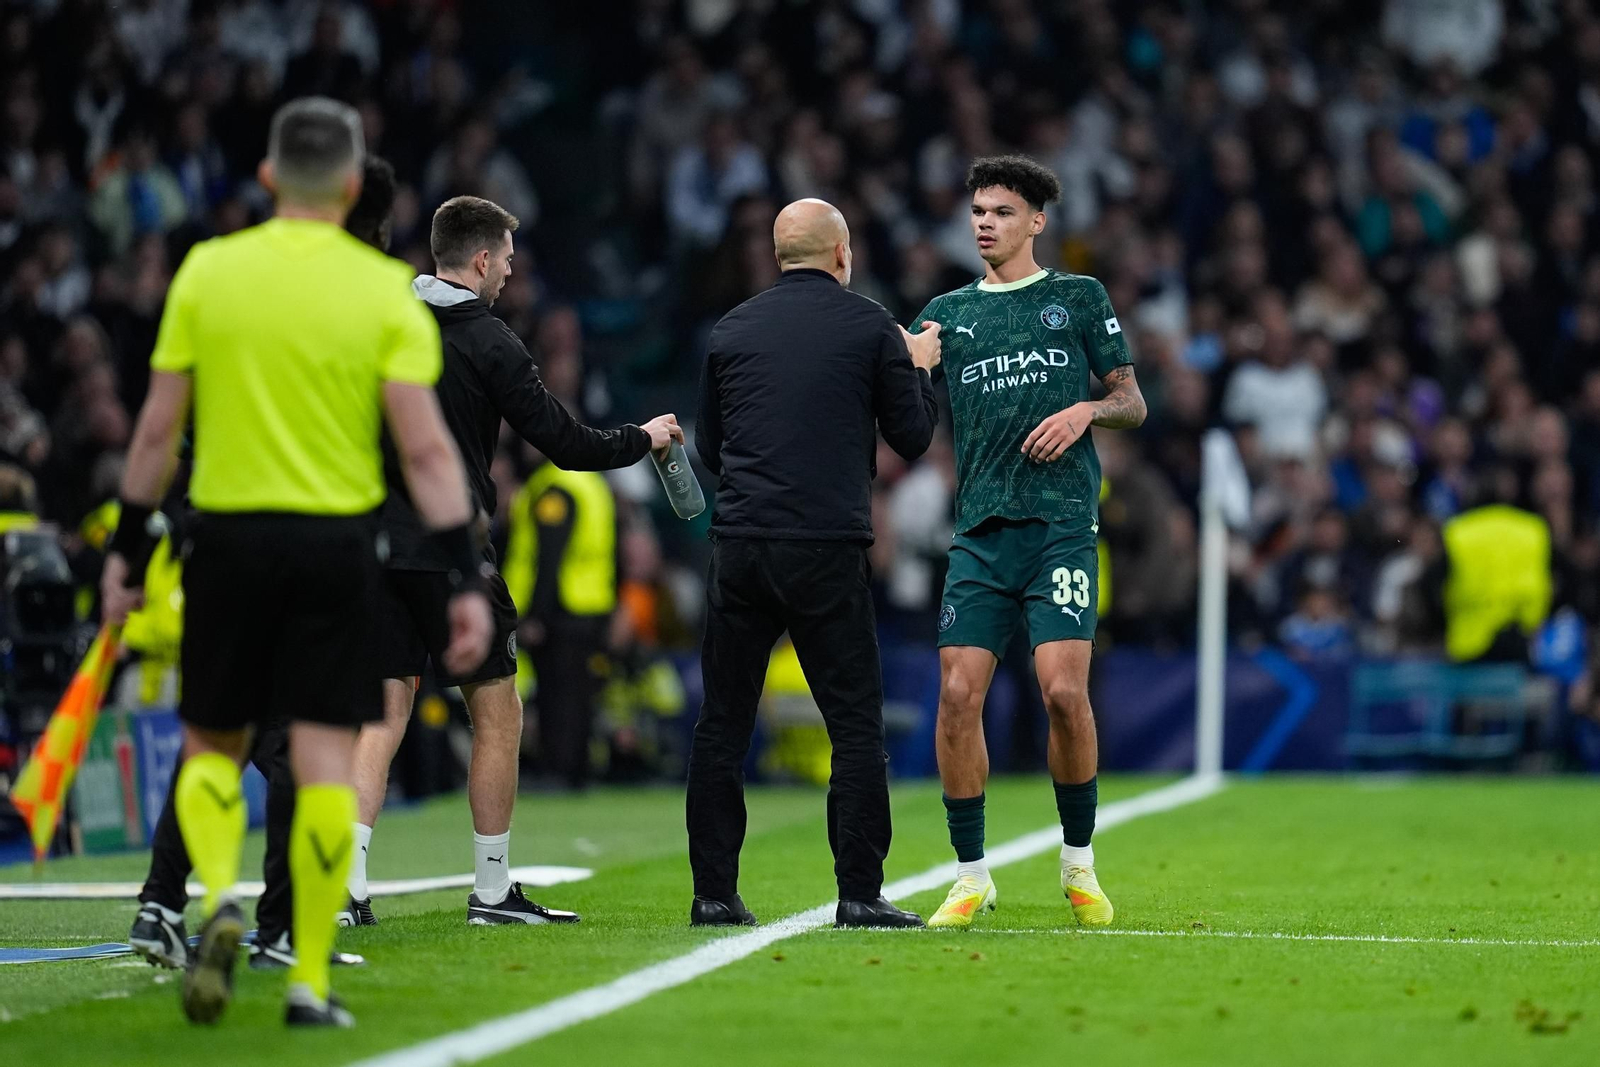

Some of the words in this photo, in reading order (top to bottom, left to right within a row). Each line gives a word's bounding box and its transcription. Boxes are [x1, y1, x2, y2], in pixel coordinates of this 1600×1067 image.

[961, 348, 1069, 384] ETIHAD
[982, 371, 1048, 394] AIRWAYS
[667, 461, 680, 473] G
[1052, 566, 1090, 608] 33
